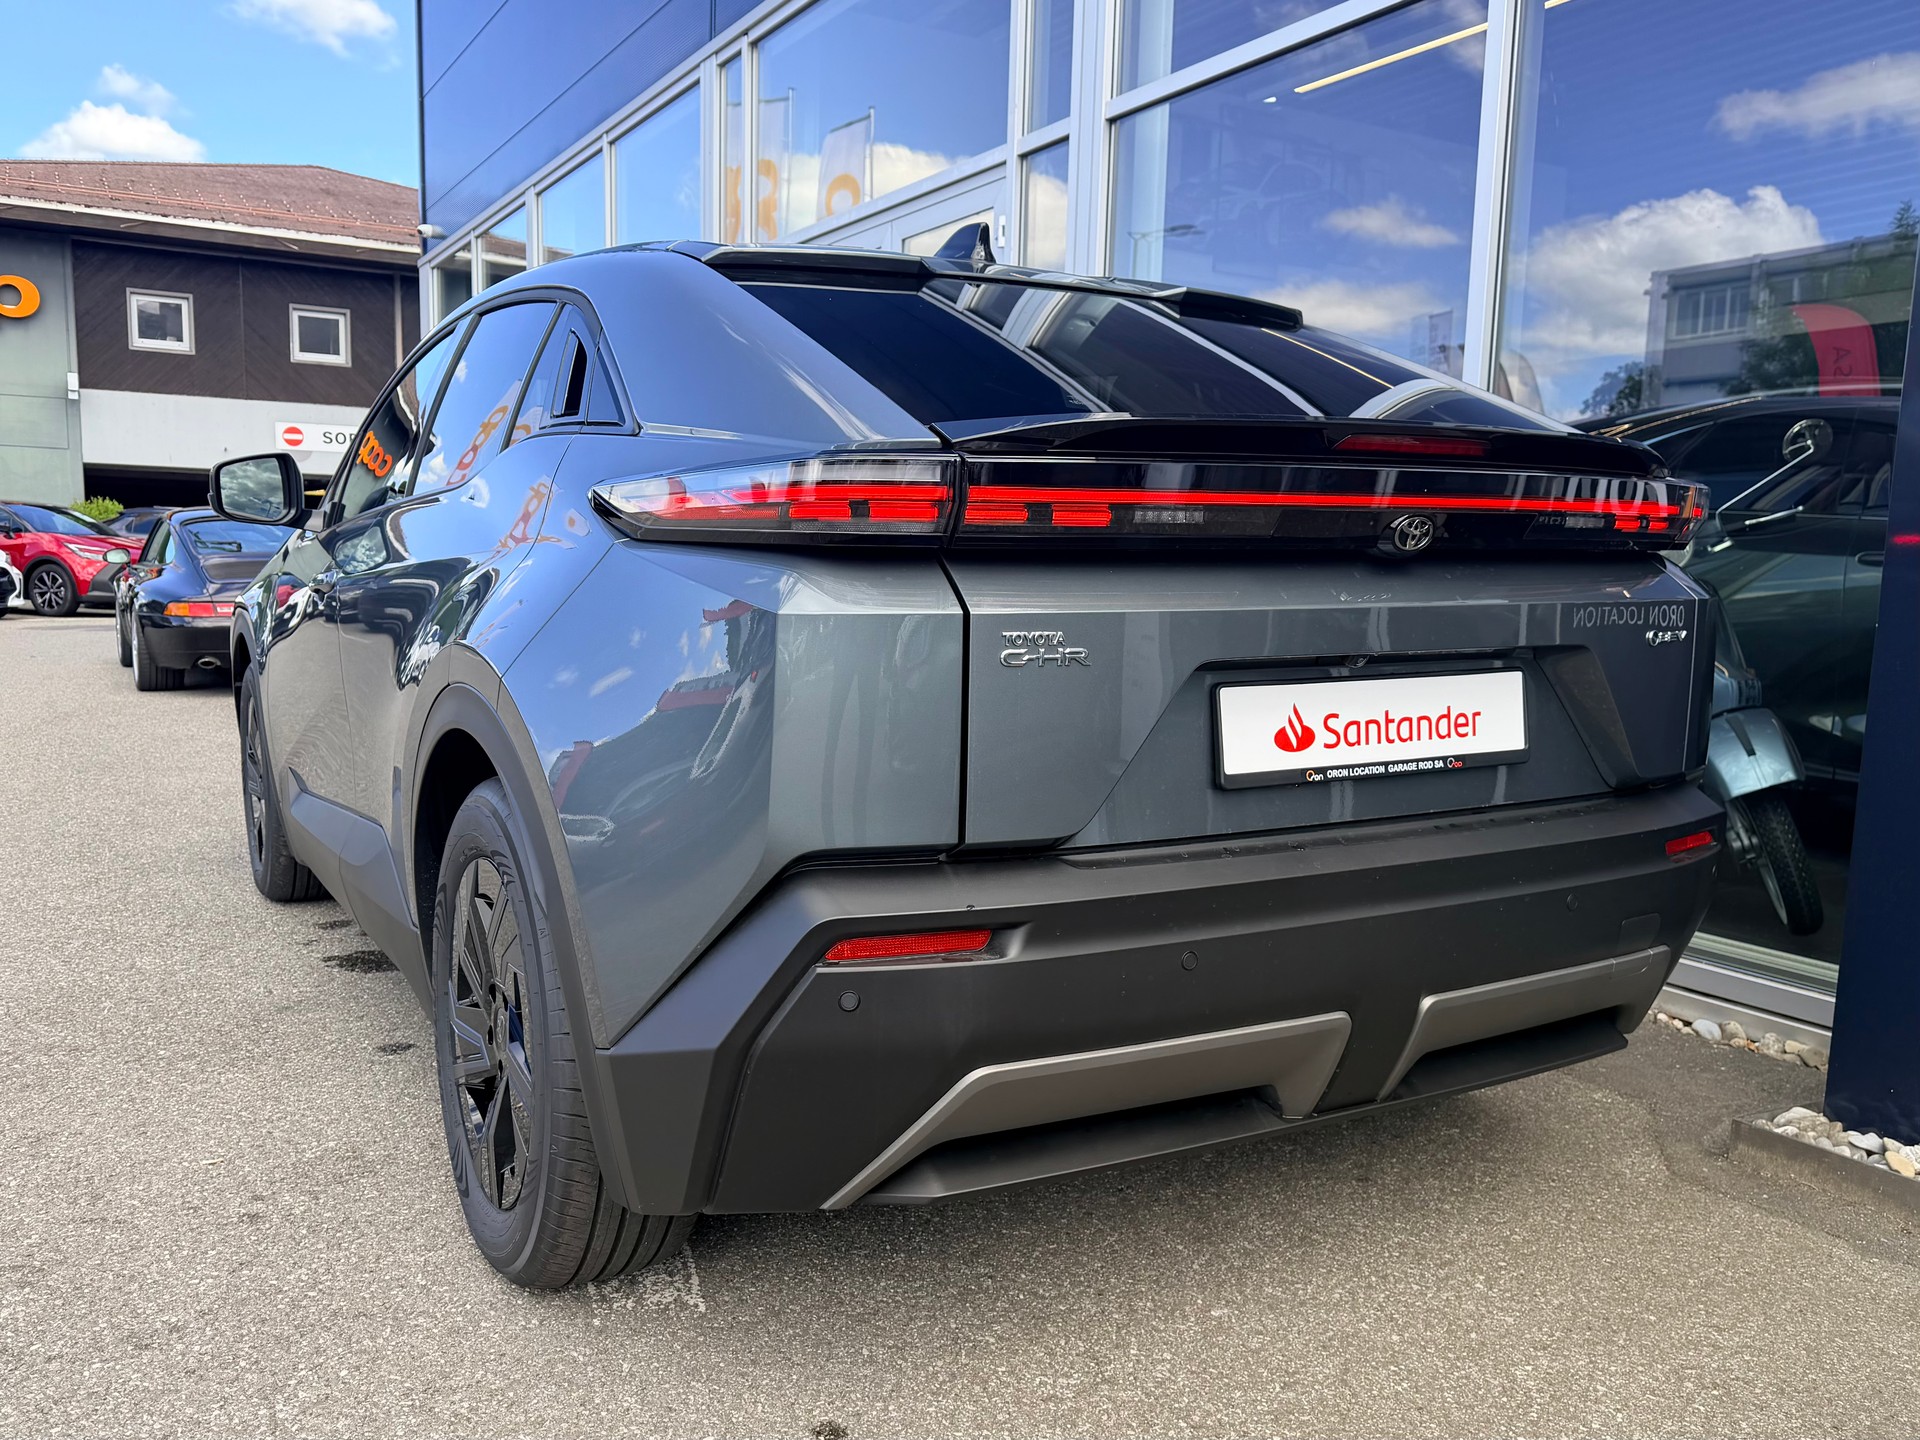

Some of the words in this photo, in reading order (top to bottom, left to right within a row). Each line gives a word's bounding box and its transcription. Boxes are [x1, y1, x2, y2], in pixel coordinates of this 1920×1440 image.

[1002, 631, 1066, 646] TOYOTA
[1000, 648, 1091, 667] C-HR
[1323, 706, 1481, 749] Santander
[1327, 768, 1348, 778] ORON
[1350, 765, 1385, 777] LOCATION
[1388, 762, 1417, 773] GARAGE
[1418, 760, 1433, 770] ROD
[1434, 759, 1444, 768] SA
